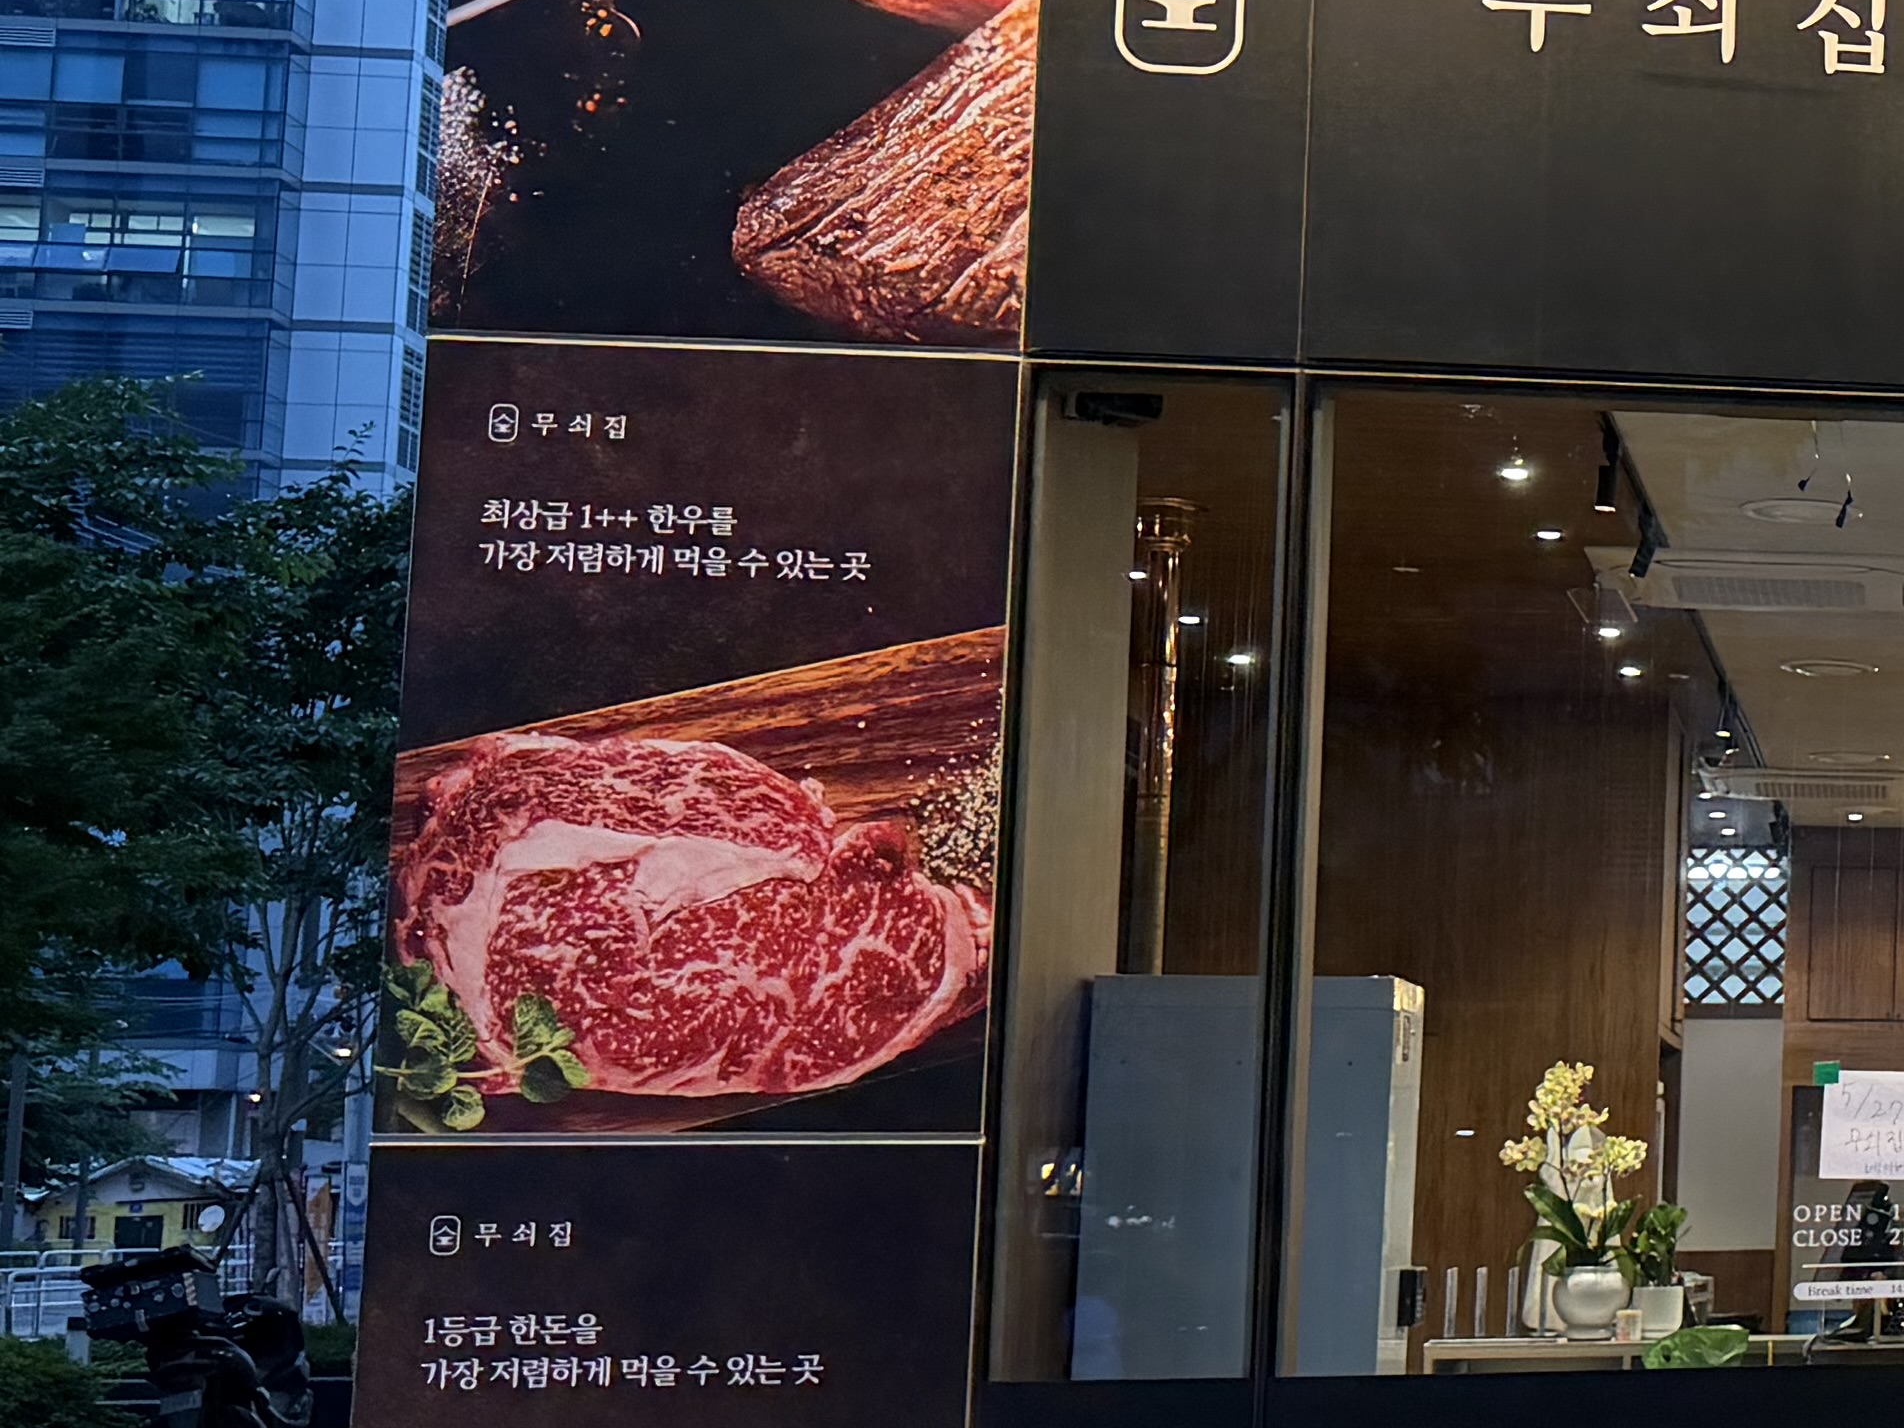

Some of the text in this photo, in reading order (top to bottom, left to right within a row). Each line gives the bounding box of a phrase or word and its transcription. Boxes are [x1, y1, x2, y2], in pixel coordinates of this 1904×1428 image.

[530, 412, 627, 440] 무쇠집
[480, 498, 738, 536] 최상급 1++ 한우를
[478, 540, 872, 582] 가장 저렴하게 먹을 수 있는 곳
[1793, 1203, 1863, 1223] OPEN
[473, 1221, 574, 1248] 무쇠집
[1792, 1228, 1863, 1248] CLOSE
[1807, 1285, 1842, 1297] Break
[1846, 1284, 1874, 1296] time
[423, 1312, 604, 1348] 1등급 한돈을
[420, 1353, 825, 1390] 가장 저렴하게 먹을 수 있는 곳
